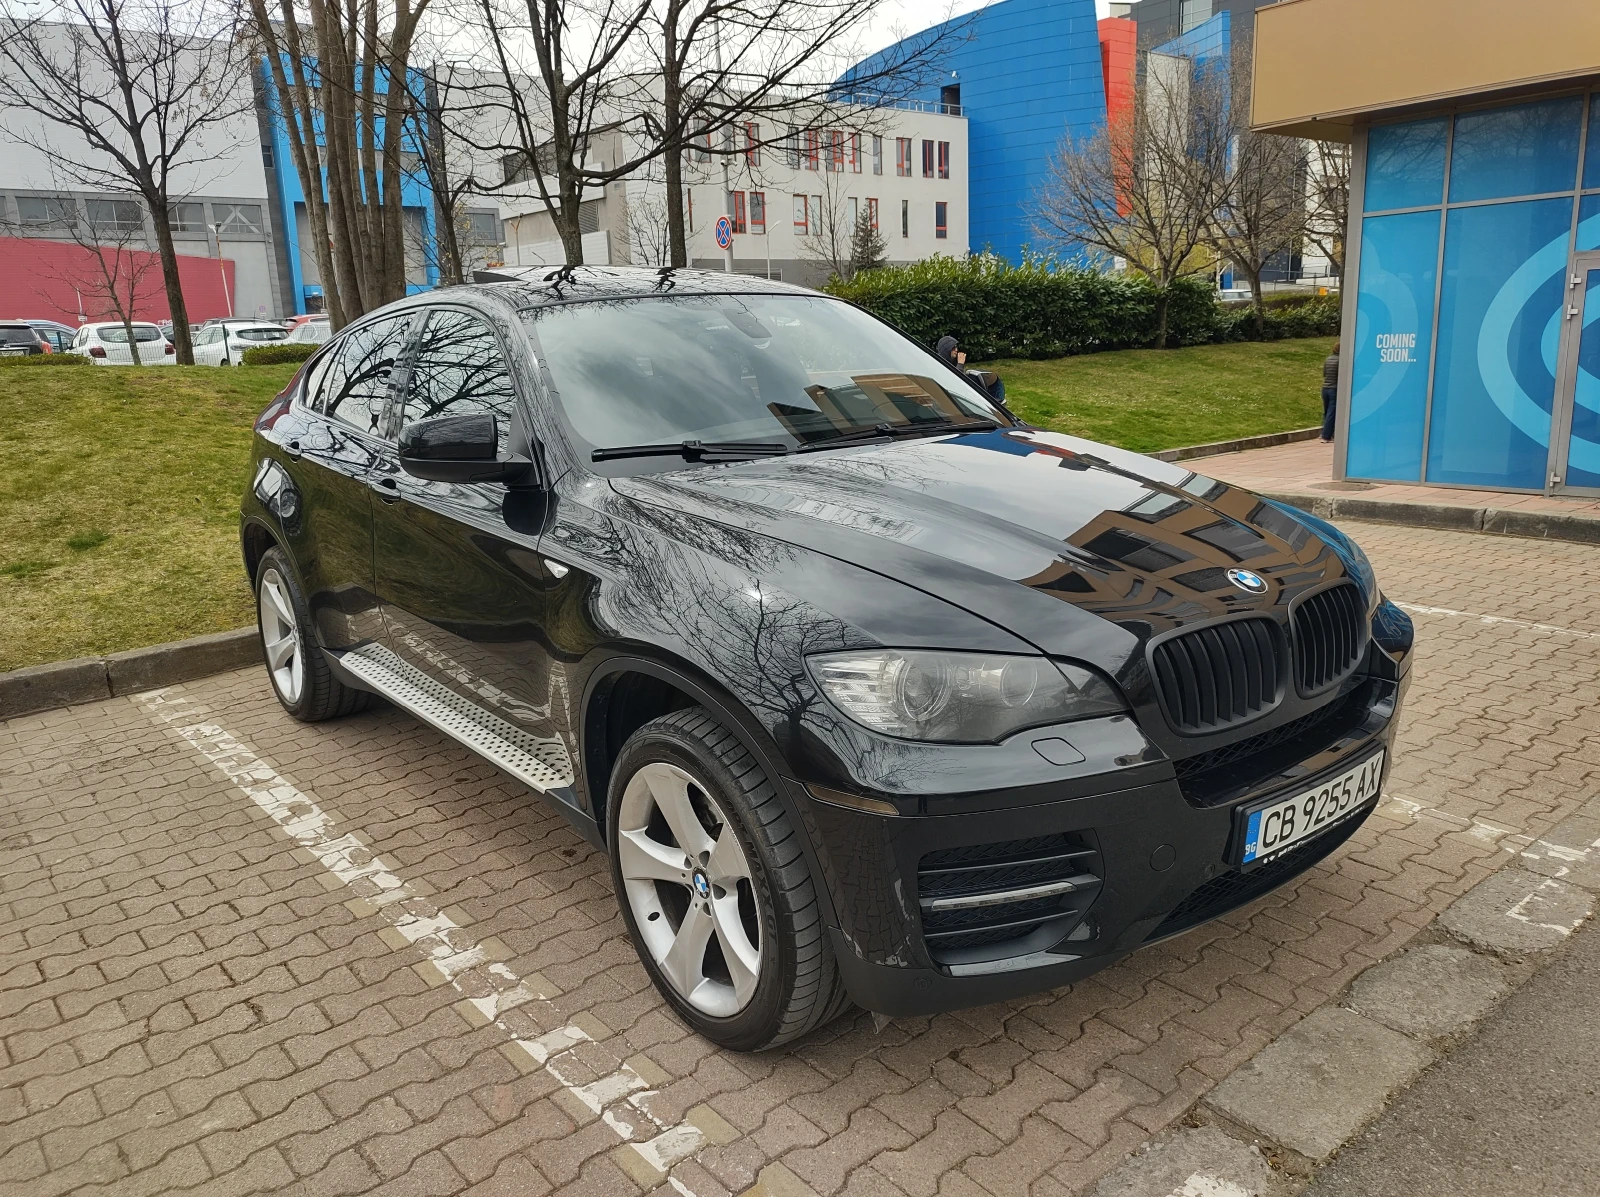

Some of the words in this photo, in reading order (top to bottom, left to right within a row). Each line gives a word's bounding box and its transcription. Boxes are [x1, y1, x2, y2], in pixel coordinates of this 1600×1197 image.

[1376, 333, 1416, 348] COMING
[1380, 348, 1417, 363] SOON...
[1262, 804, 1296, 849] CB
[1302, 774, 1354, 832] 9255
[1353, 757, 1380, 803] AX
[1245, 841, 1257, 856] BG
[744, 841, 774, 906] MAXX
[767, 914, 779, 946] GT
